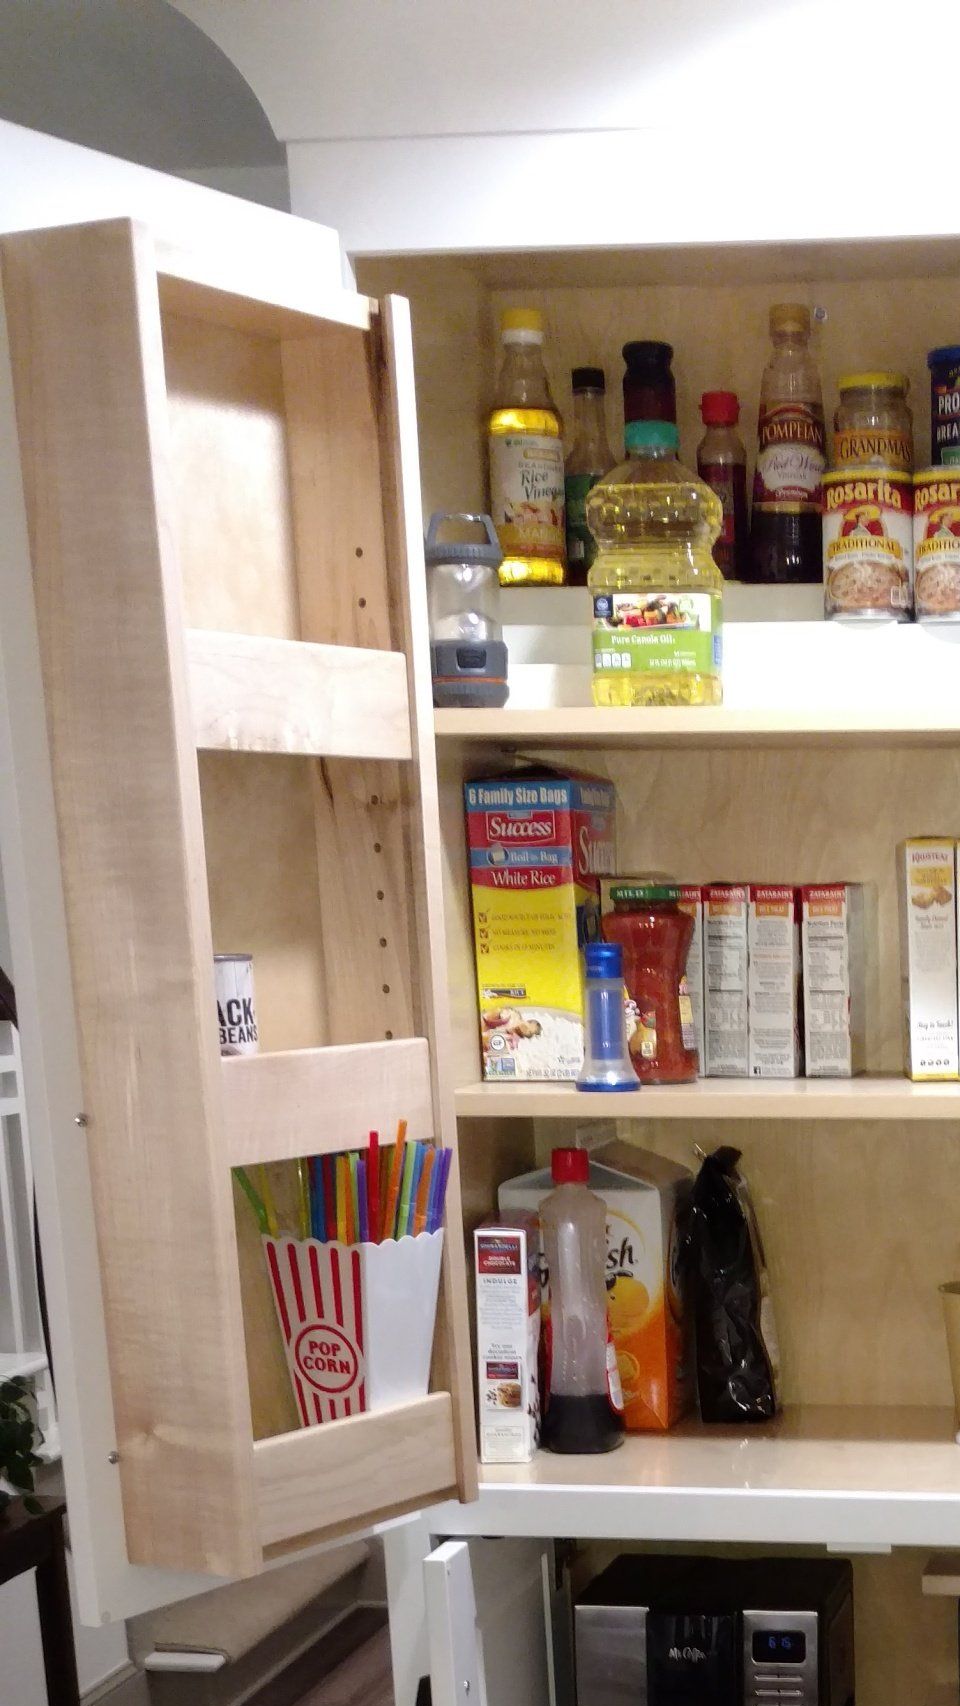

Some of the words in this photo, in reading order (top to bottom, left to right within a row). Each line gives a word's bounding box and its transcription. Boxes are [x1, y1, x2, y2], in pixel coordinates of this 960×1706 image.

[762, 421, 823, 444] POMPEIAN
[827, 479, 902, 511] Rosarita
[832, 540, 896, 553] TRADITIONAL
[468, 787, 478, 804] 6
[478, 786, 514, 806] Family
[514, 787, 539, 804] Size
[539, 786, 569, 807] Bags
[489, 816, 553, 838] Success
[490, 867, 528, 887] White
[529, 868, 556, 886] Rice
[216, 997, 254, 1027] ACK
[219, 1025, 258, 1045] BEANS
[308, 1340, 341, 1357] POP
[302, 1356, 351, 1374] CORN
